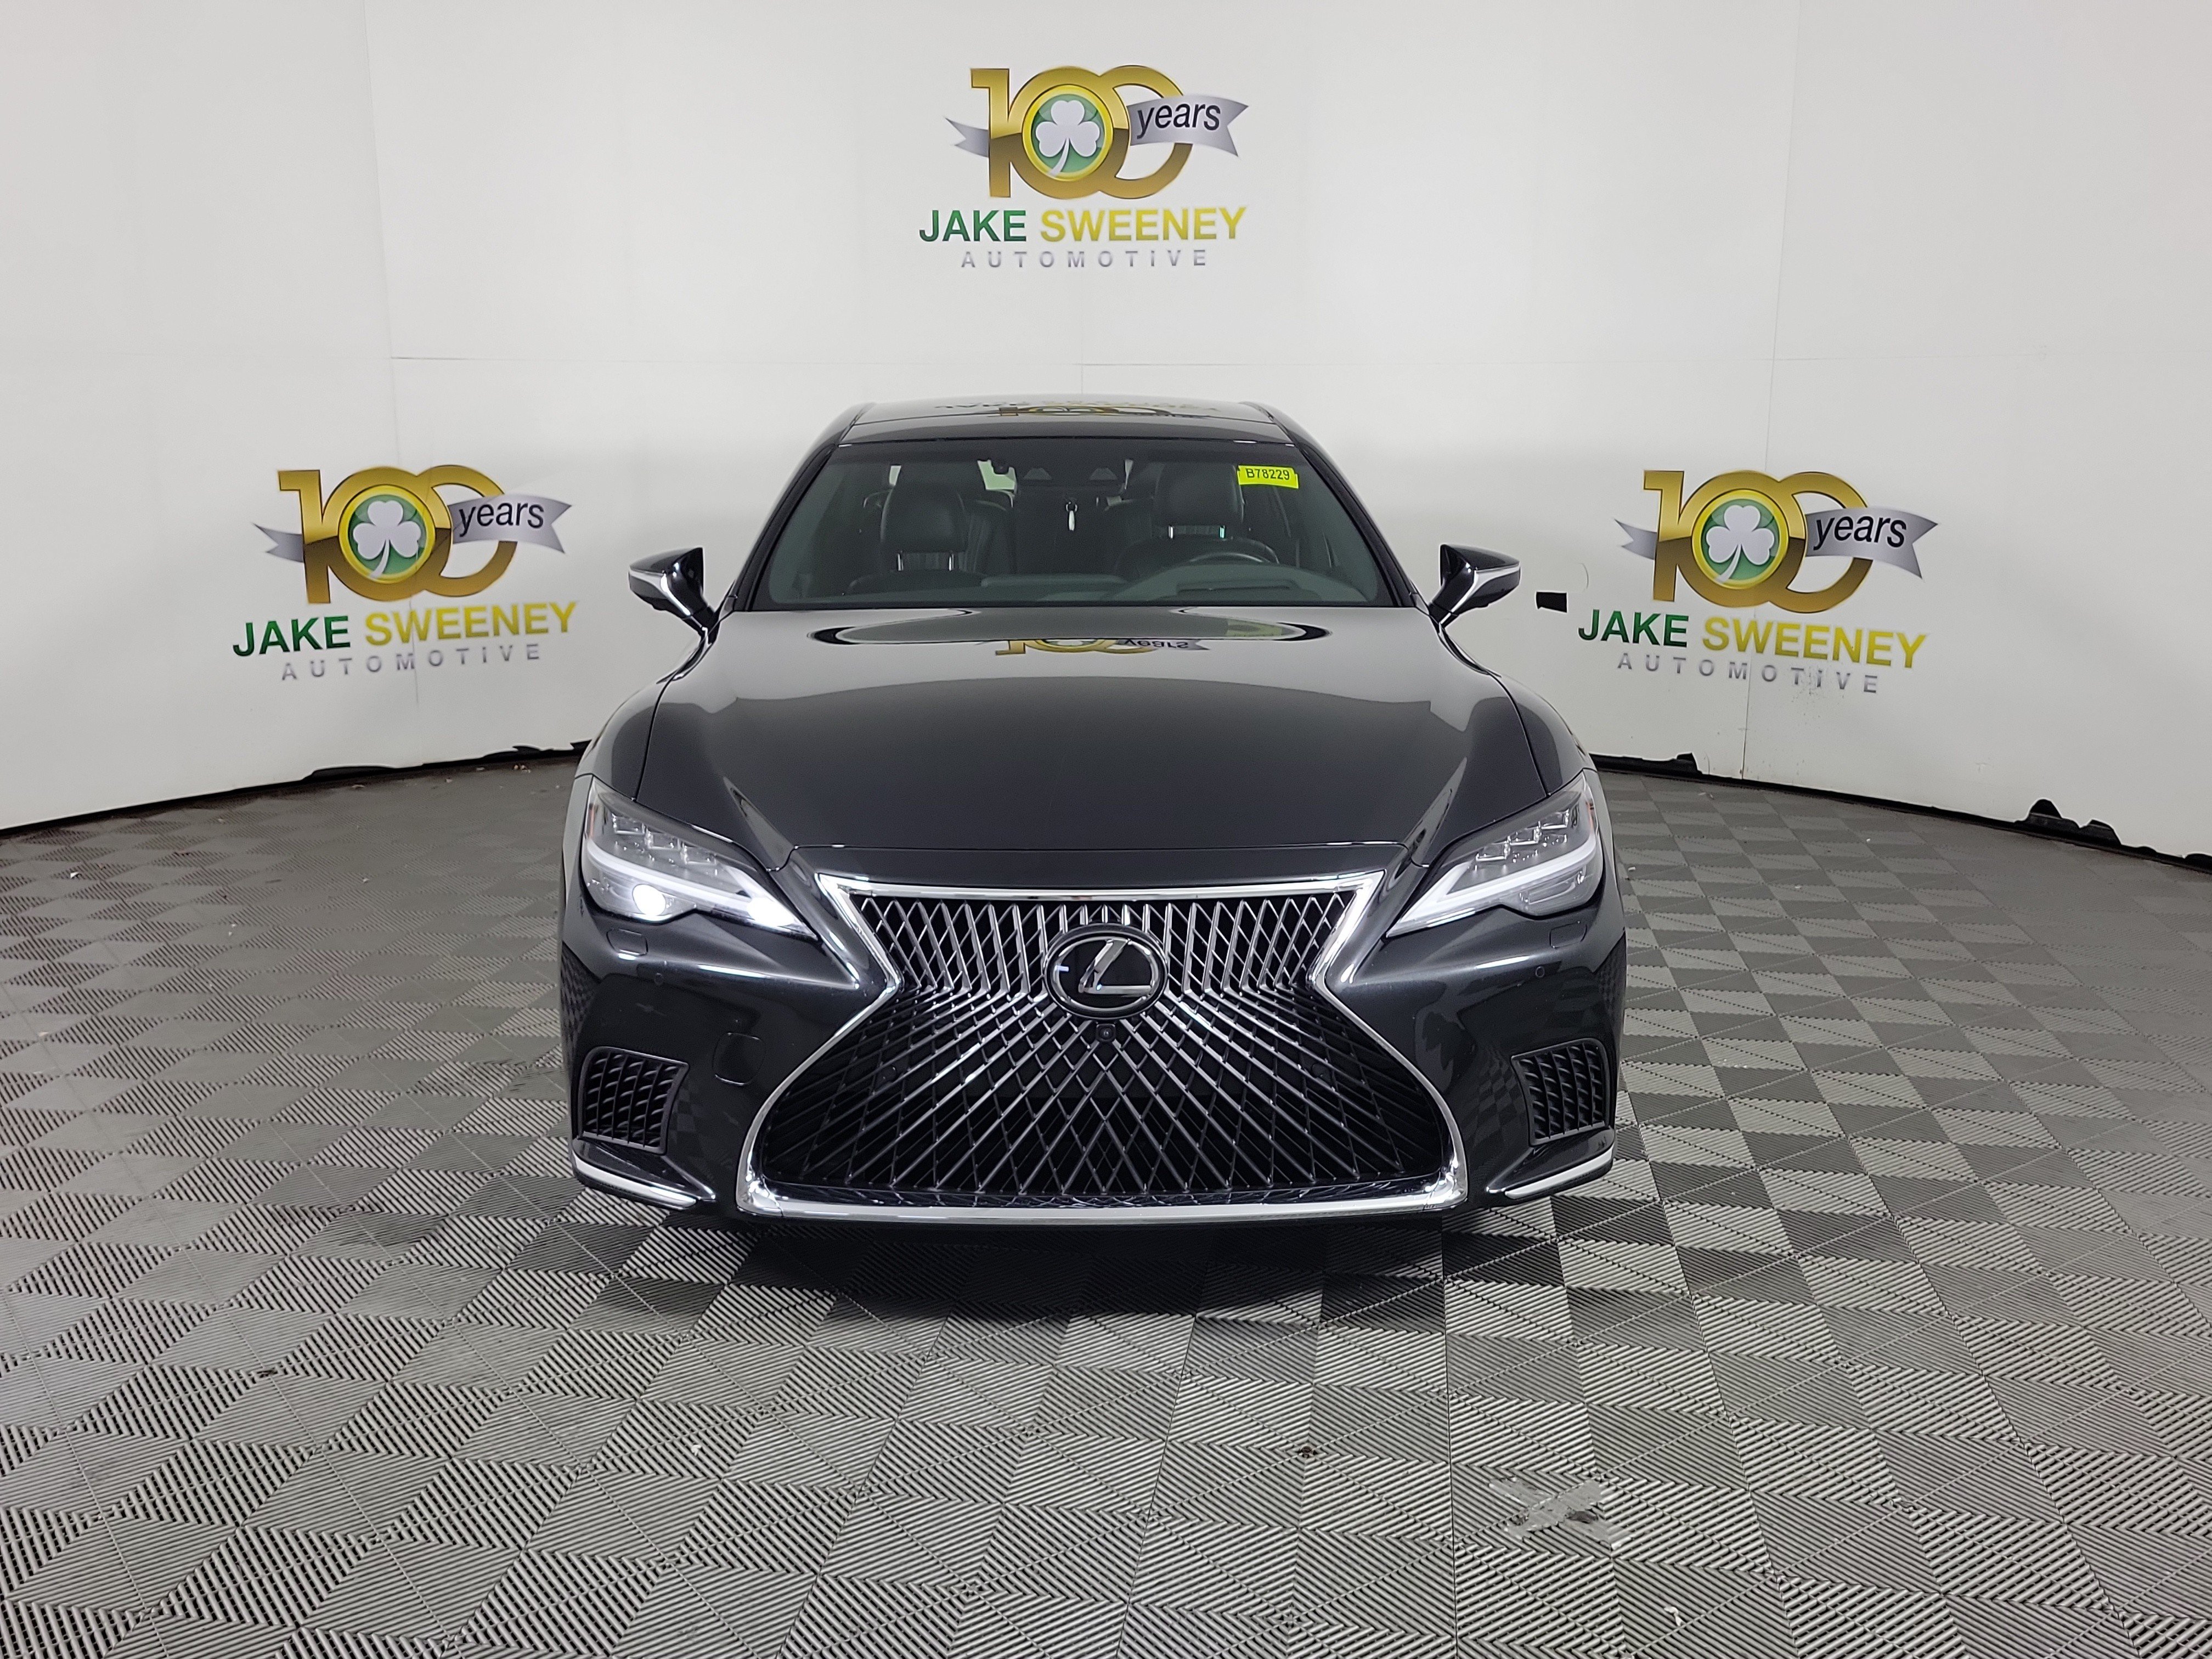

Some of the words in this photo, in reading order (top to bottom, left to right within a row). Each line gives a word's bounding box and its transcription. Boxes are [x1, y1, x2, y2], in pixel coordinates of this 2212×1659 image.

[970, 65, 1194, 199] 100
[1136, 103, 1221, 139] years
[919, 210, 1026, 242] JAKE
[1041, 206, 1248, 242] SWEENEY
[961, 249, 1206, 268] AUTOMOTIVE
[1245, 468, 1290, 480] B78229
[277, 465, 518, 604] 100
[459, 502, 544, 537] years
[1643, 470, 1874, 613] 100
[1813, 516, 1907, 550] years
[232, 616, 351, 657] JAKE
[365, 601, 579, 647] SWEENEY
[1578, 608, 1689, 647] JAKE
[1702, 616, 1927, 668] SWEENEY
[280, 644, 540, 681] AUTOMOTIVE
[1617, 652, 1878, 693] AUTOMOTIVE
